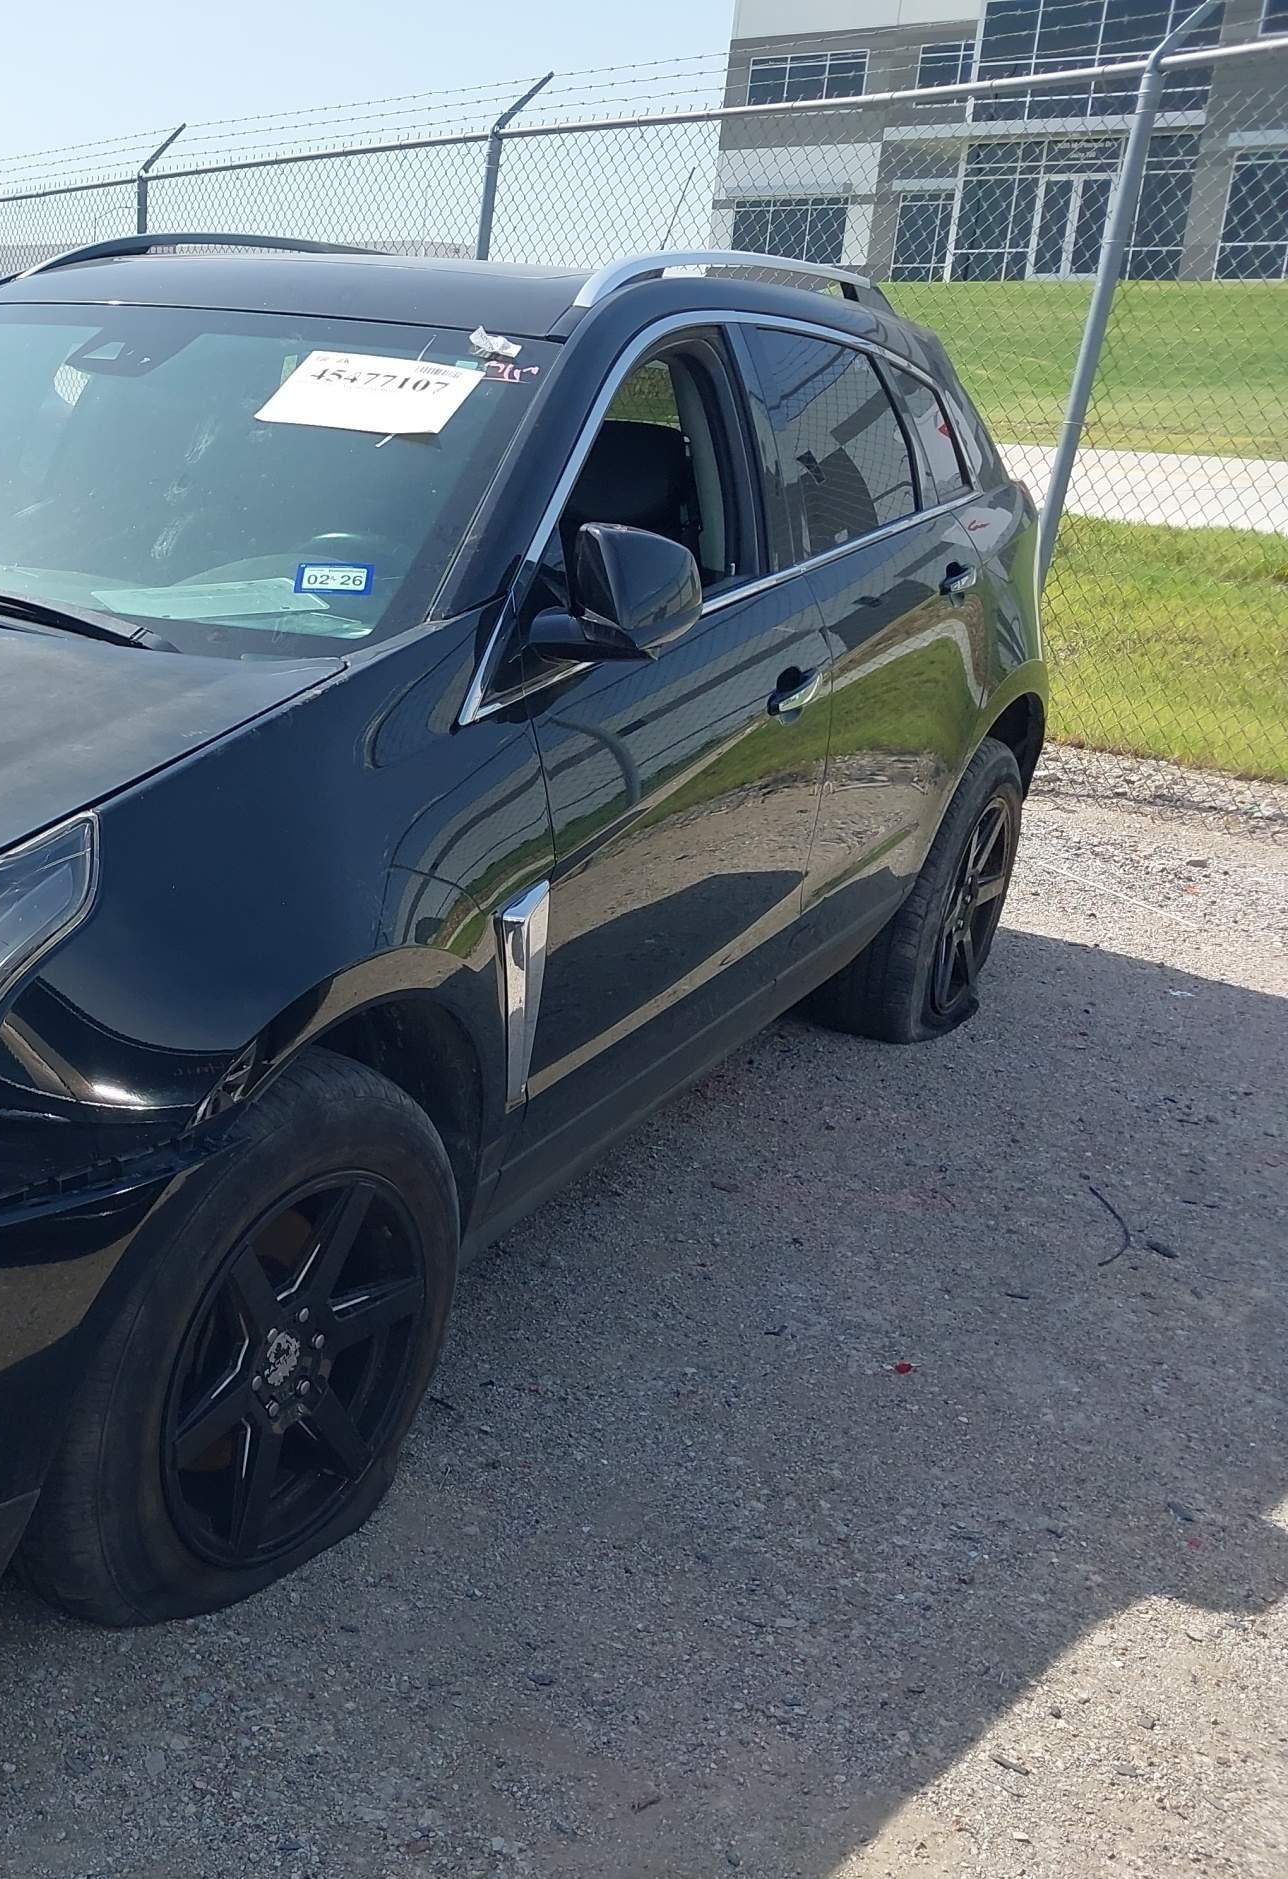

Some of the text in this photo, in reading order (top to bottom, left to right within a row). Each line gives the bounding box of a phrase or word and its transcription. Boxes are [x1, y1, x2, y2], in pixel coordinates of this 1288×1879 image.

[310, 368, 450, 394] 45477107
[307, 574, 363, 586] 02 26
